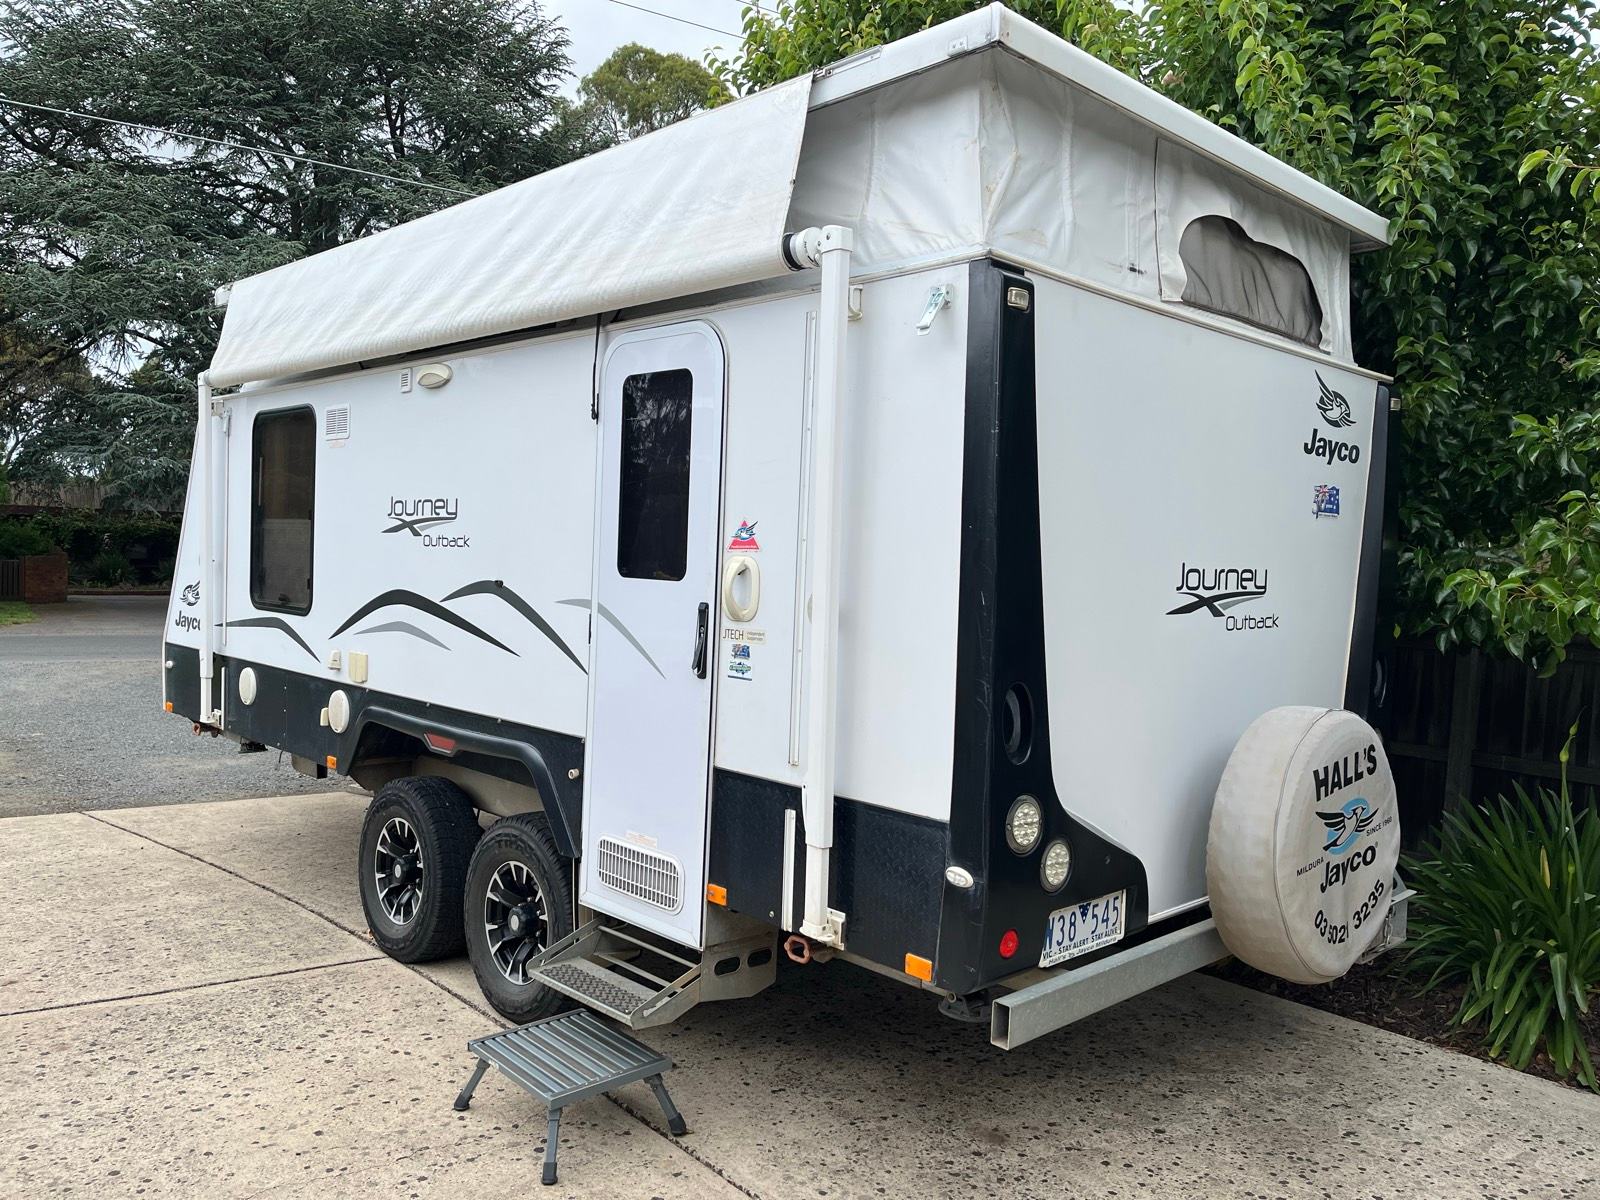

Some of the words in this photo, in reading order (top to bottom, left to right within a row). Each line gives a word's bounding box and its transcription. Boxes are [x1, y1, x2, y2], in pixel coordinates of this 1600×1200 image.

[1303, 428, 1360, 466] Jayco
[386, 495, 458, 520] Journey
[423, 534, 470, 548] Outback
[1176, 562, 1268, 595] Journey
[722, 628, 744, 640] JTECH
[1226, 613, 1279, 631] Outback
[1313, 744, 1377, 802] HALL'S
[1366, 822, 1382, 837] SINCE
[1296, 856, 1324, 877] MILDURA
[1320, 845, 1376, 893] Jayco
[1091, 895, 1119, 935] 545
[1314, 909, 1328, 938] 03
[1327, 920, 1349, 945] 5021
[1352, 879, 1385, 930] 3235
[1042, 950, 1053, 960] VIC
[1058, 944, 1072, 955] STAY
[1072, 938, 1089, 949] ALERT
[1091, 933, 1104, 943] STAY
[1104, 927, 1118, 937] ALIVE
